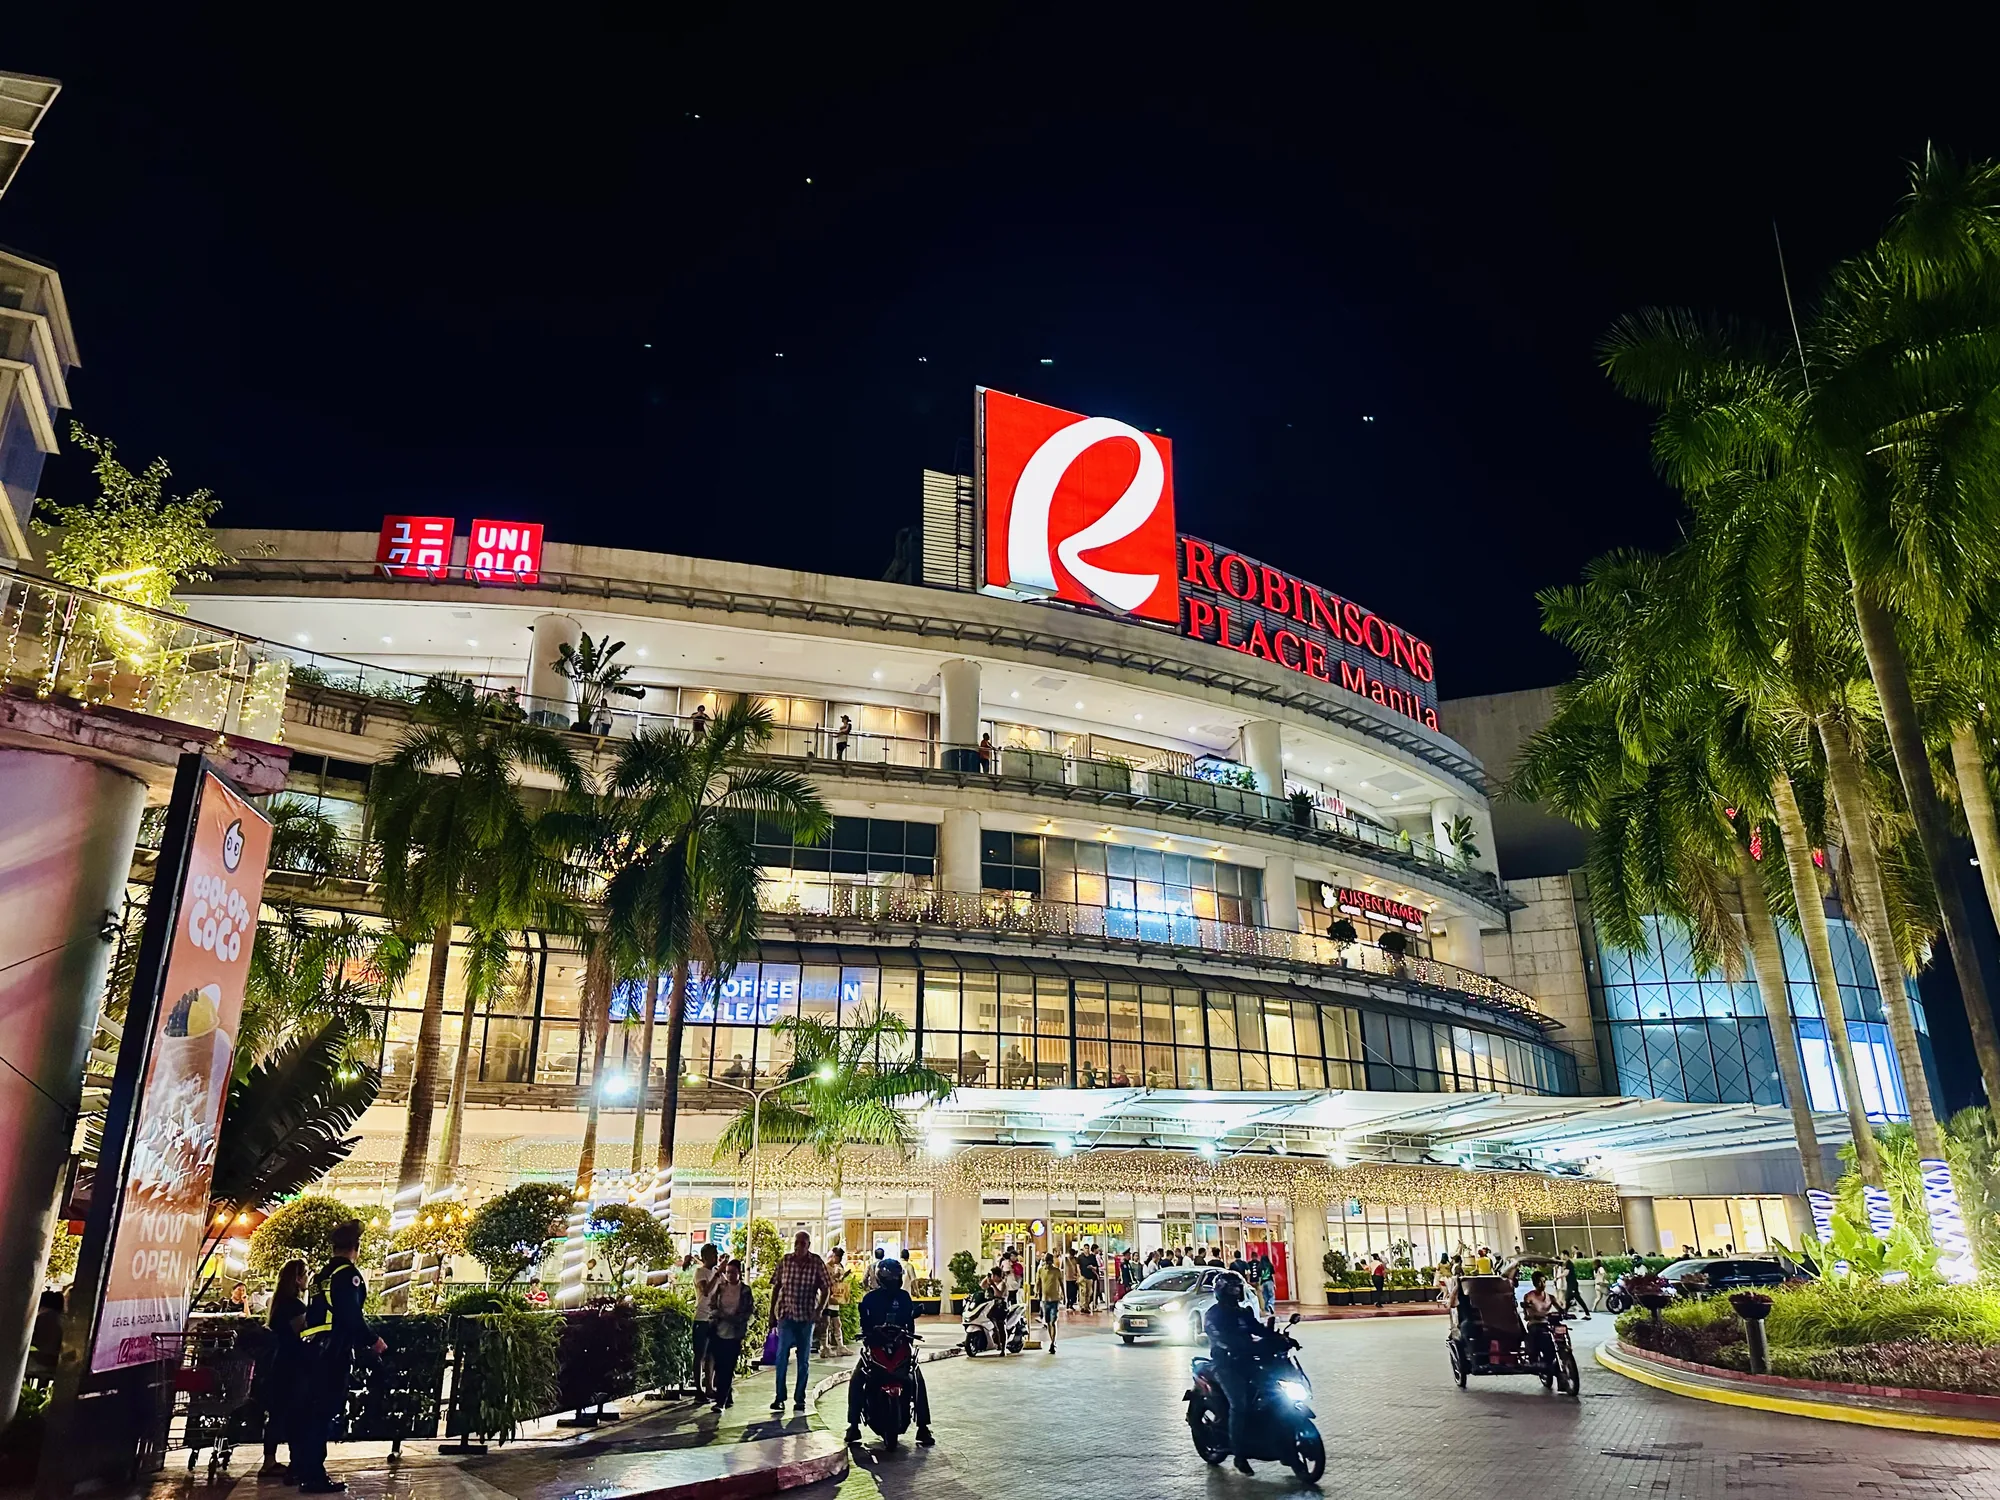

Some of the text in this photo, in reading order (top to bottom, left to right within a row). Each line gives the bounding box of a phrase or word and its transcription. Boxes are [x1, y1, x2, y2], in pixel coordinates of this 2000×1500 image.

[478, 527, 530, 552] UNI
[1181, 537, 1434, 683] ROBINSONS
[1185, 597, 1439, 732] PLACE Manila
[1340, 888, 1383, 911] AJISEN
[1384, 899, 1423, 923] RAMEN
[140, 1212, 187, 1244] NOW
[989, 1222, 1027, 1234] HOUSE
[132, 1250, 182, 1283] OPEN
